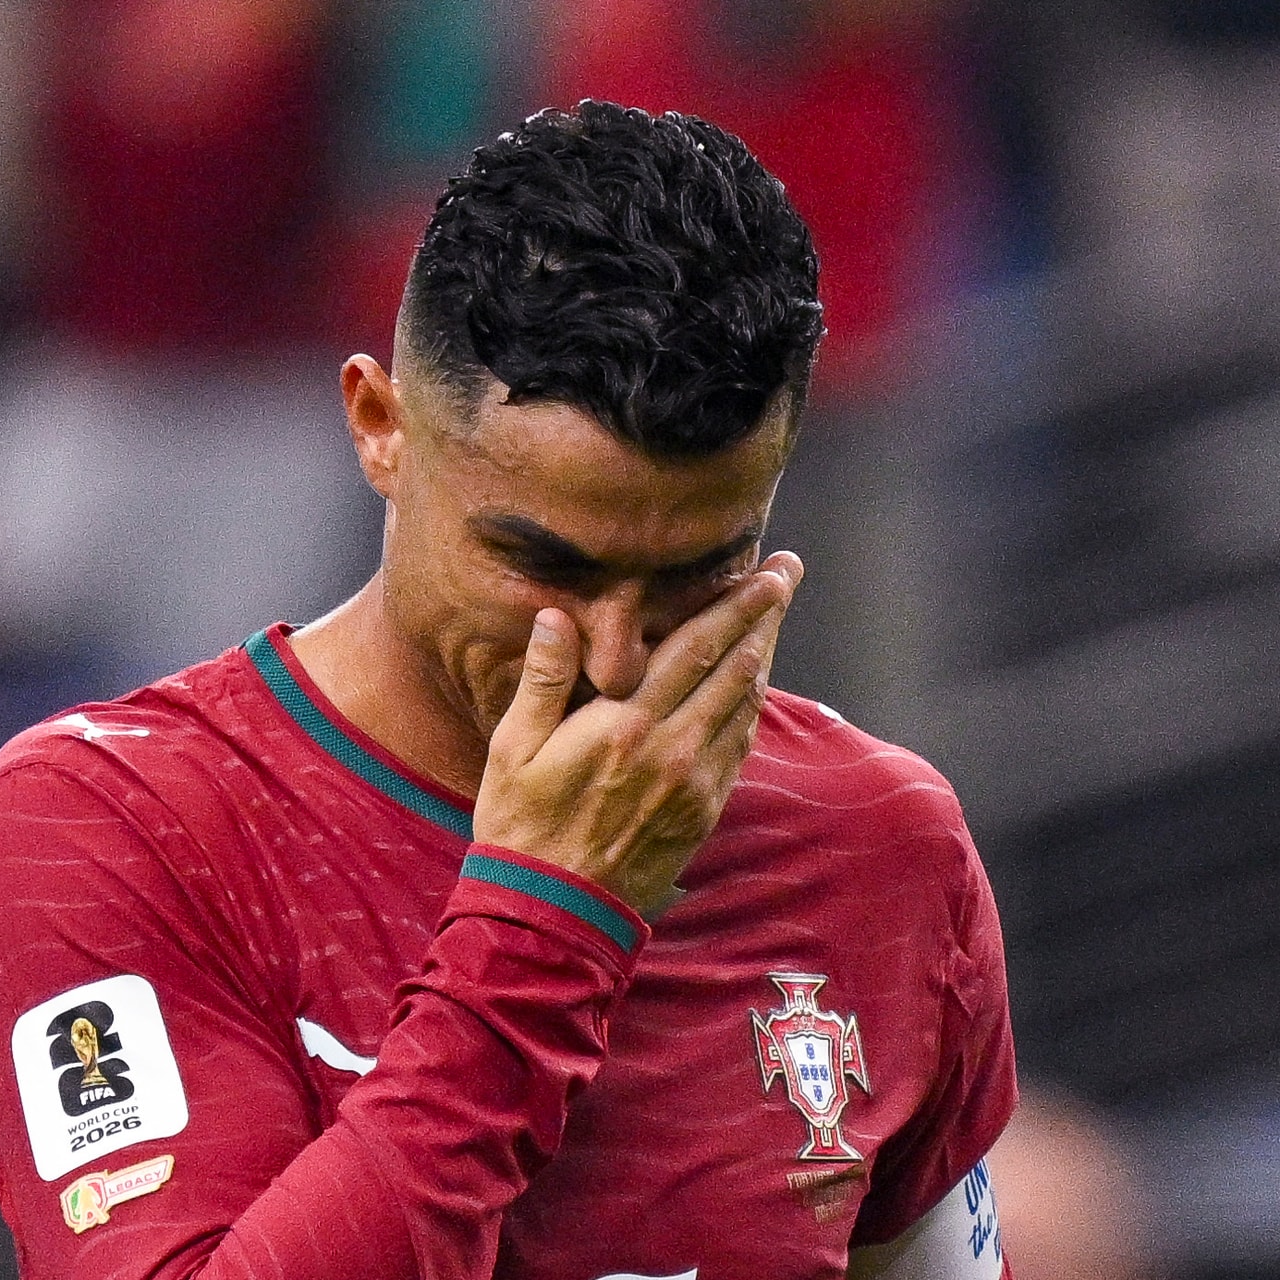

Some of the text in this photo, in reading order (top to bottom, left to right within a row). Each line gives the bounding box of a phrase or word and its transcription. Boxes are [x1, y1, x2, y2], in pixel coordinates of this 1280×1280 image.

[80, 1086, 116, 1106] FIFA
[67, 1105, 139, 1136] WORLD CUP
[70, 1116, 142, 1153] 2026
[108, 1170, 161, 1194] LEGACY
